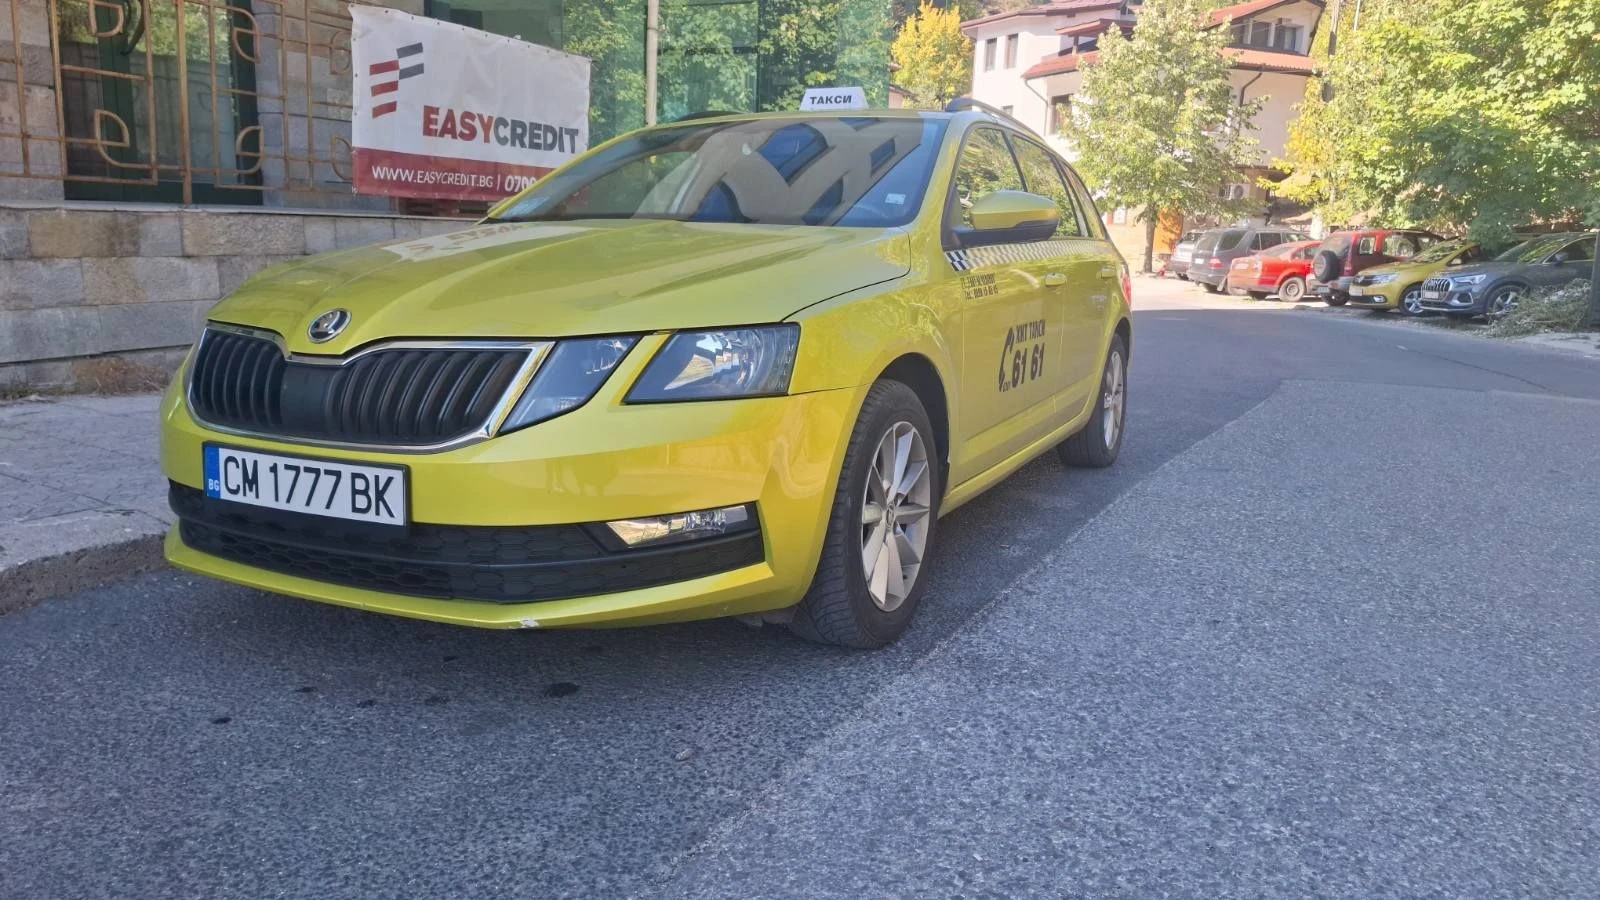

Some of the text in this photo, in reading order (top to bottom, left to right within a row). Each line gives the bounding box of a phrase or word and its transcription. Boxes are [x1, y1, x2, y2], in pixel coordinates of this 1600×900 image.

[809, 95, 852, 105] ТАКСИ
[423, 105, 578, 154] EASYCREDIT
[371, 165, 493, 189] WWW.EASYCREDIT.BG
[1012, 342, 1045, 388] 61 61
[208, 478, 220, 491] BG
[224, 456, 395, 518] CM 1777 BK
